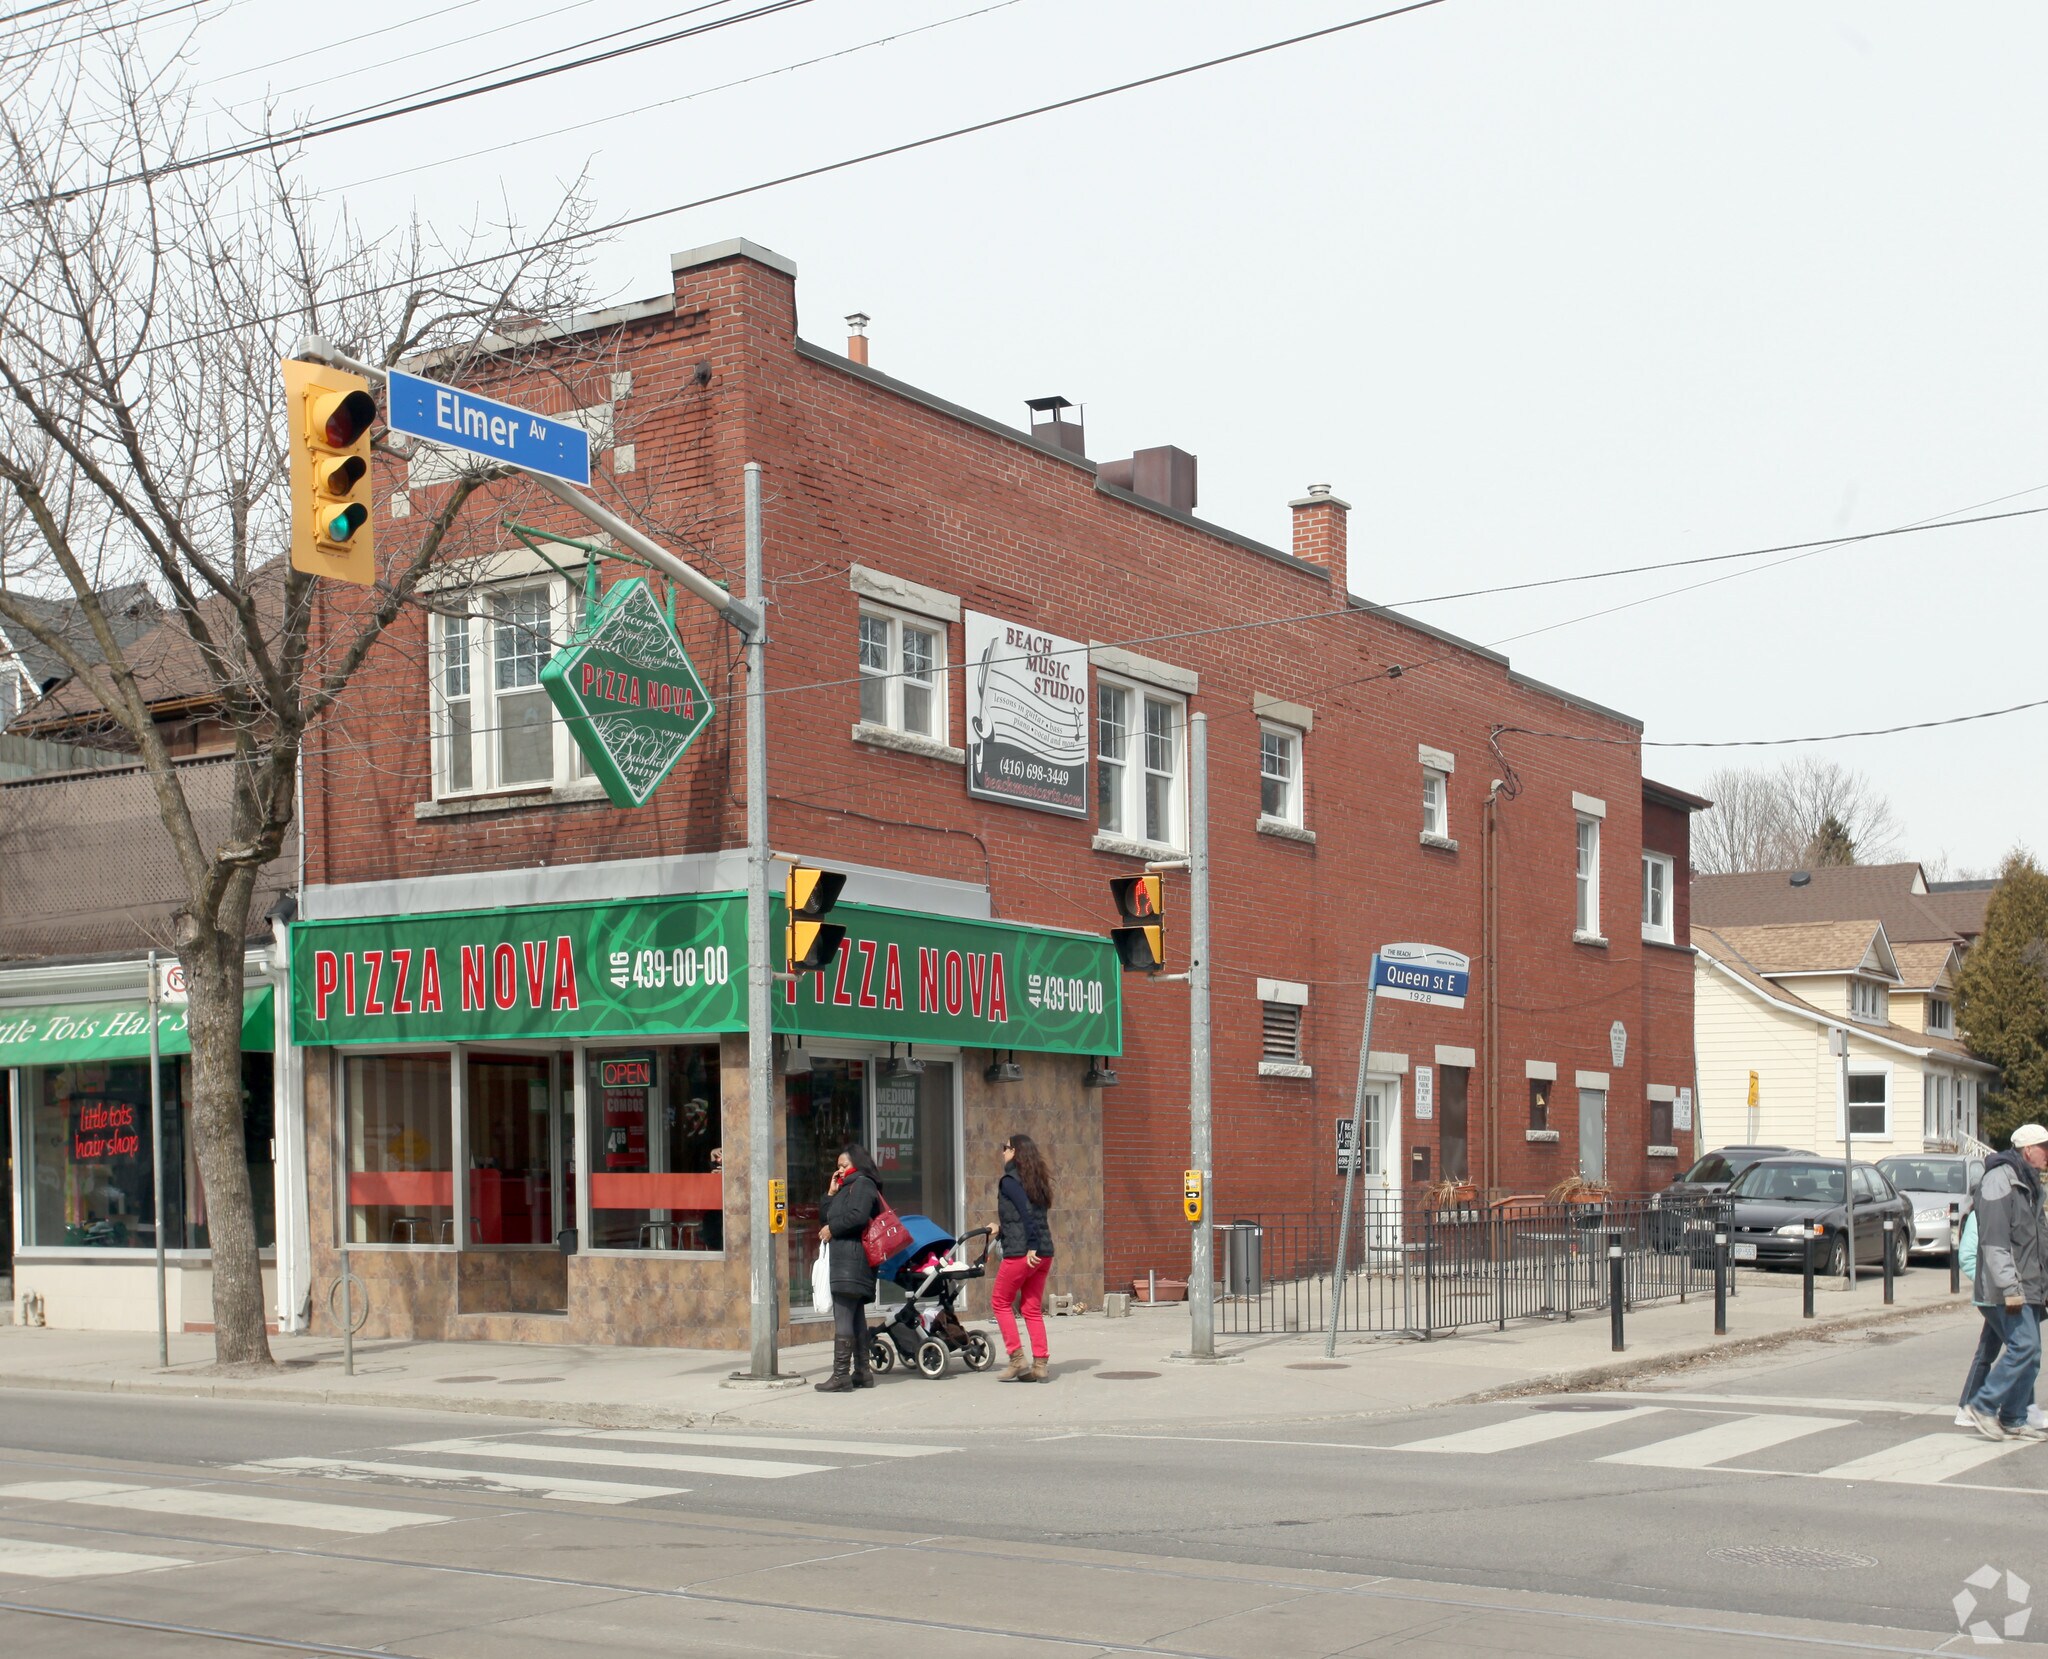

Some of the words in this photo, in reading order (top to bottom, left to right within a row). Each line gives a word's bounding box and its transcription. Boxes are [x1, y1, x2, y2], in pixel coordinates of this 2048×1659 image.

[437, 390, 518, 448] Elmer
[529, 420, 546, 441] Av
[1006, 626, 1053, 656] BEACH
[1026, 653, 1070, 681] MUSIC
[582, 662, 640, 706] PIZZA
[648, 680, 694, 720] NOVA
[1034, 676, 1085, 705] STUDIO
[994, 693, 1017, 708] lessons
[1018, 702, 1025, 712] in
[1026, 708, 1044, 725] guitar
[1050, 722, 1063, 734] bass
[1013, 717, 1030, 730] piano
[1034, 728, 1050, 742] vocal
[1050, 738, 1060, 746] and
[1062, 740, 1076, 748] more
[1000, 756, 1024, 779] (416)
[1026, 764, 1069, 786] 698-3449
[1388, 948, 1396, 956] THE
[314, 947, 443, 1021] PIZZA
[460, 936, 579, 1011] NOVA
[610, 952, 630, 988] 416
[633, 945, 728, 988] 439-00-00
[785, 938, 904, 1011] ZZA
[919, 946, 1008, 1023] NOVA
[1028, 974, 1042, 1008] 416
[1044, 976, 1103, 1014] 439-00-00
[1387, 966, 1429, 988] Queen
[1432, 976, 1444, 990] St
[1447, 975, 1455, 992] E
[1409, 992, 1432, 1003] 1928
[40, 1016, 100, 1041] Tots
[100, 1008, 170, 1038] Har
[604, 1063, 650, 1084] OPEN
[607, 1098, 644, 1112] COMBOS
[877, 1088, 915, 1104] MEDIUM
[81, 1103, 108, 1132] little
[110, 1104, 133, 1126] tots
[877, 1117, 914, 1139] PIZZA
[75, 1134, 104, 1159] hair
[108, 1128, 138, 1158] shop
